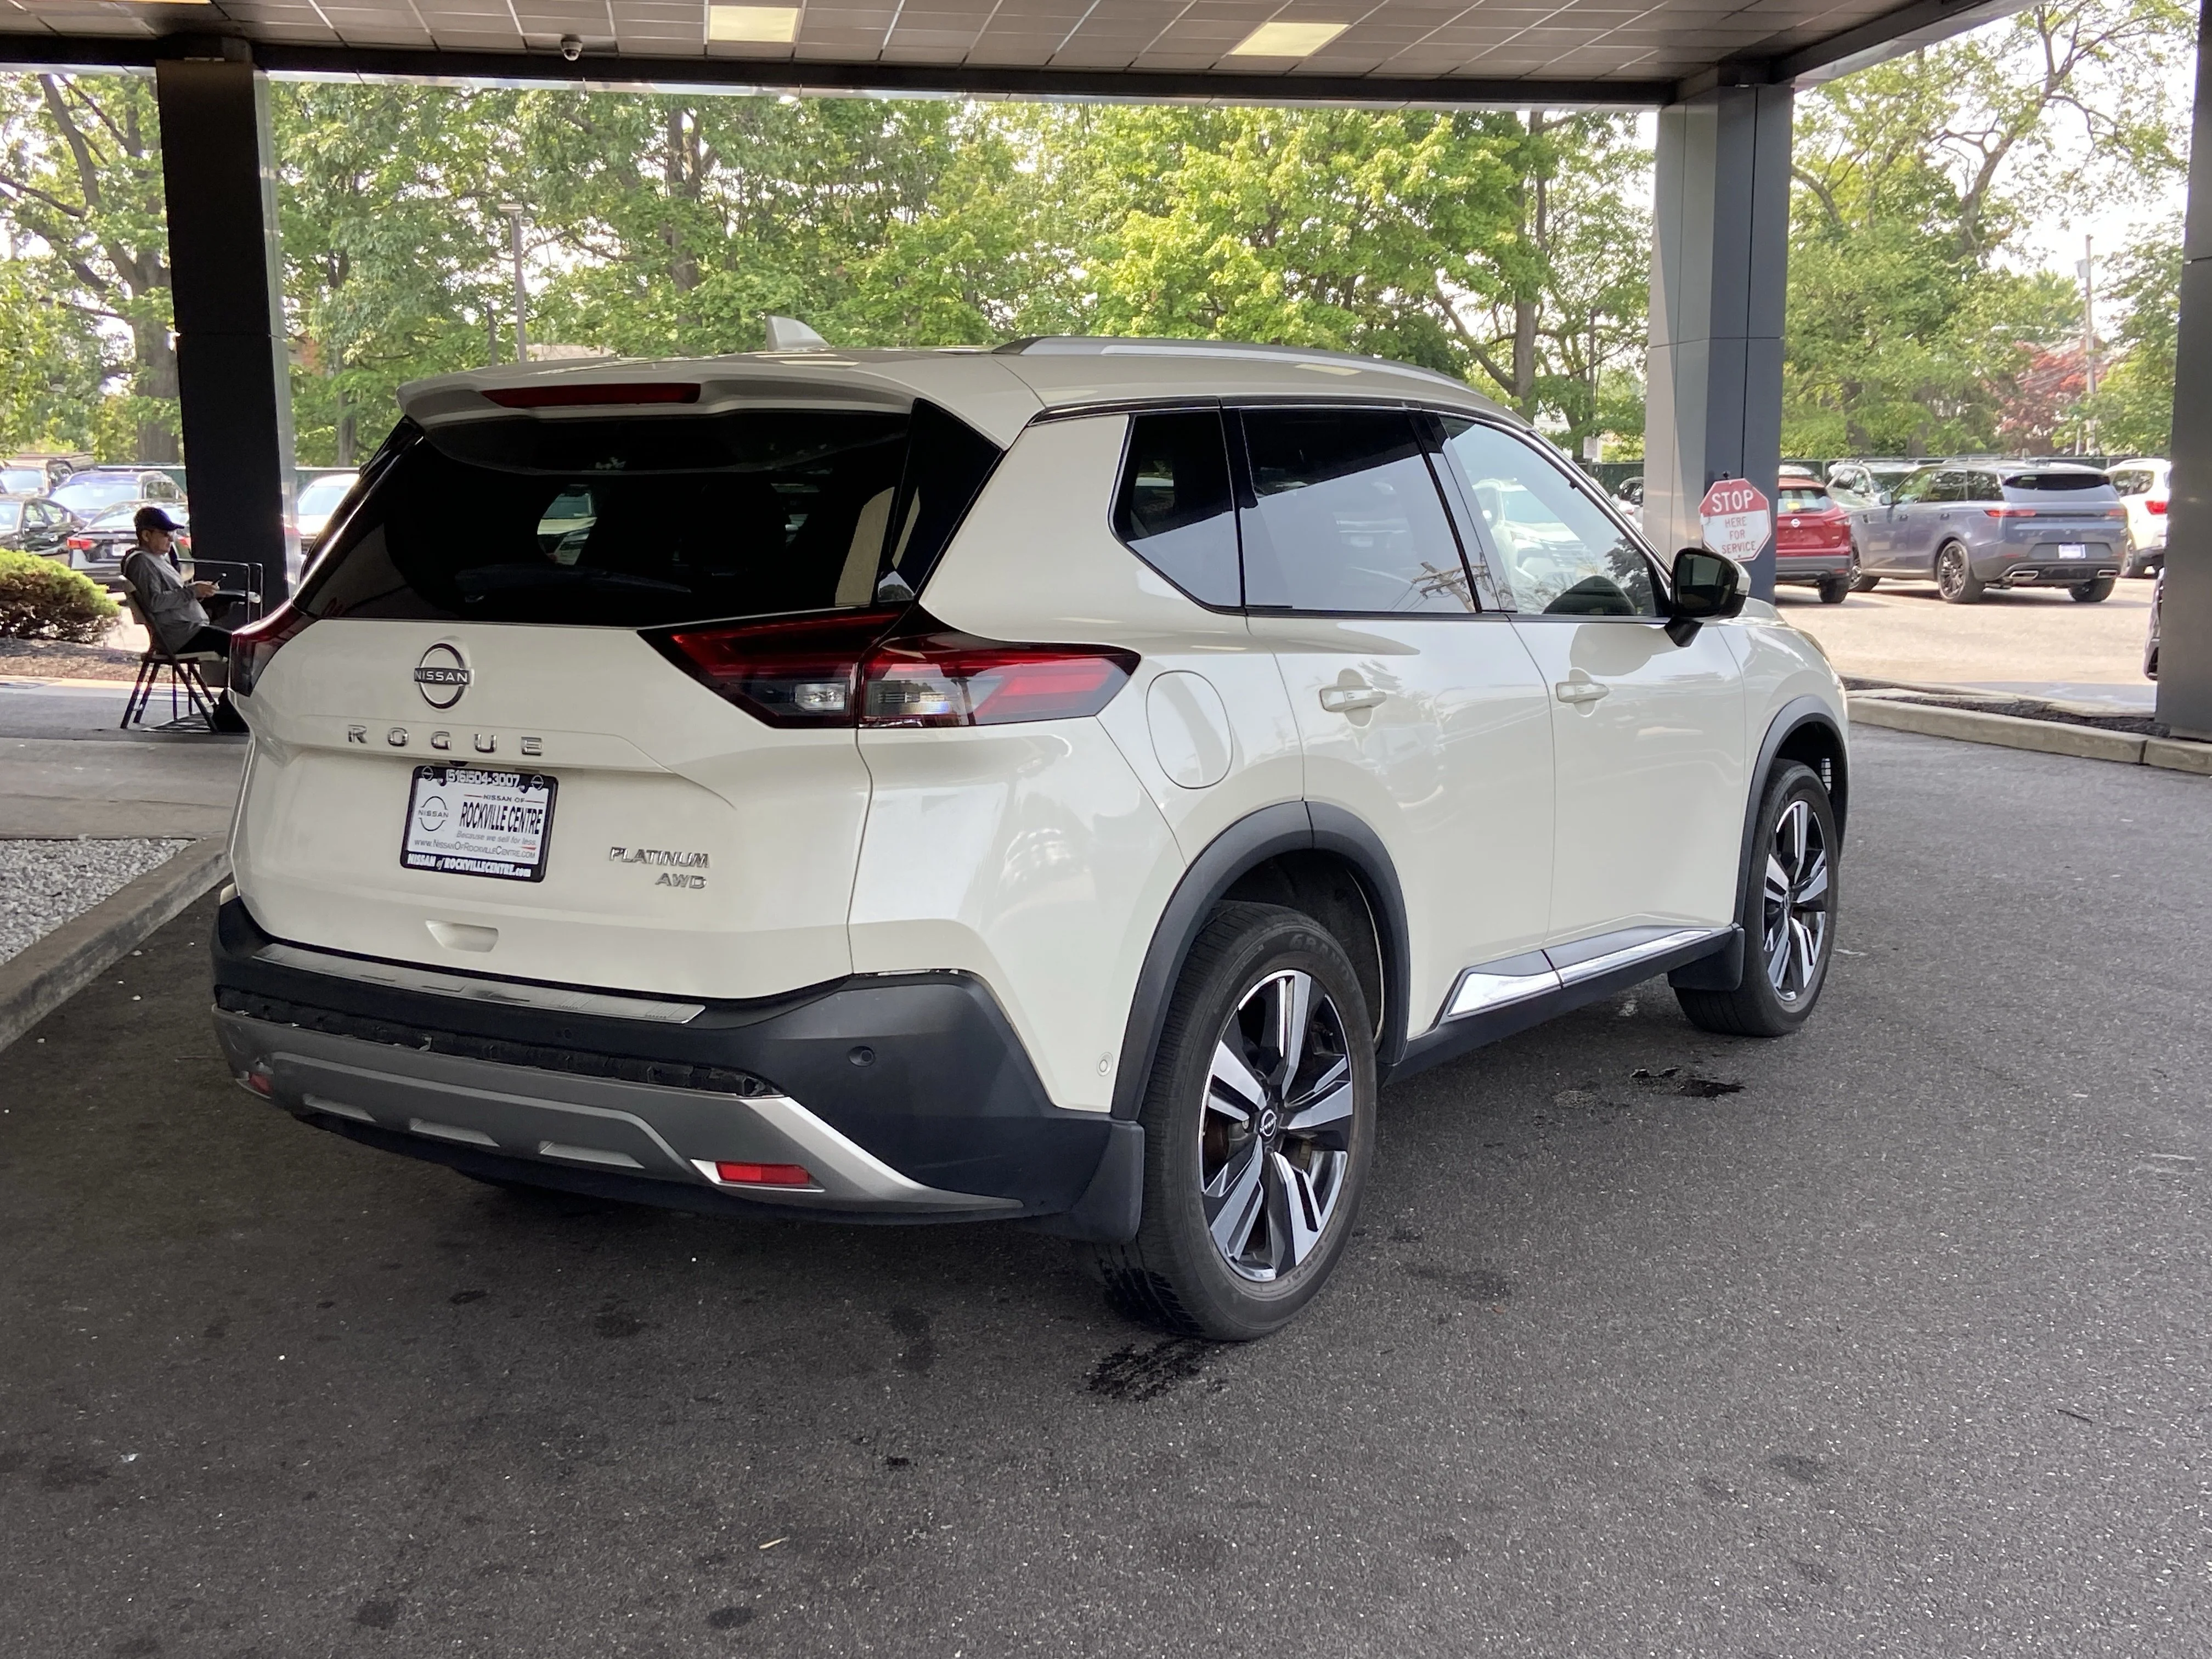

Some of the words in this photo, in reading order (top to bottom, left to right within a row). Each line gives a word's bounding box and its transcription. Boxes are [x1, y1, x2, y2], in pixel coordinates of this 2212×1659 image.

[1711, 489, 1754, 513] STOP
[1725, 516, 1747, 528] HERE
[1729, 529, 1745, 540] FOR
[1721, 540, 1756, 554] SERVICE
[415, 669, 469, 682] NISSAN
[348, 724, 543, 757] ROGUE
[482, 794, 512, 802] NISSAN
[417, 809, 449, 818] NISSAN
[459, 801, 509, 831] ROCKVILLE
[507, 805, 543, 835] CENTRE
[456, 830, 484, 840] Because
[497, 835, 509, 843] sell
[510, 836, 521, 844] for
[407, 853, 437, 867] NISSAN
[609, 847, 710, 868] PLATINUM
[654, 872, 707, 889] AWD
